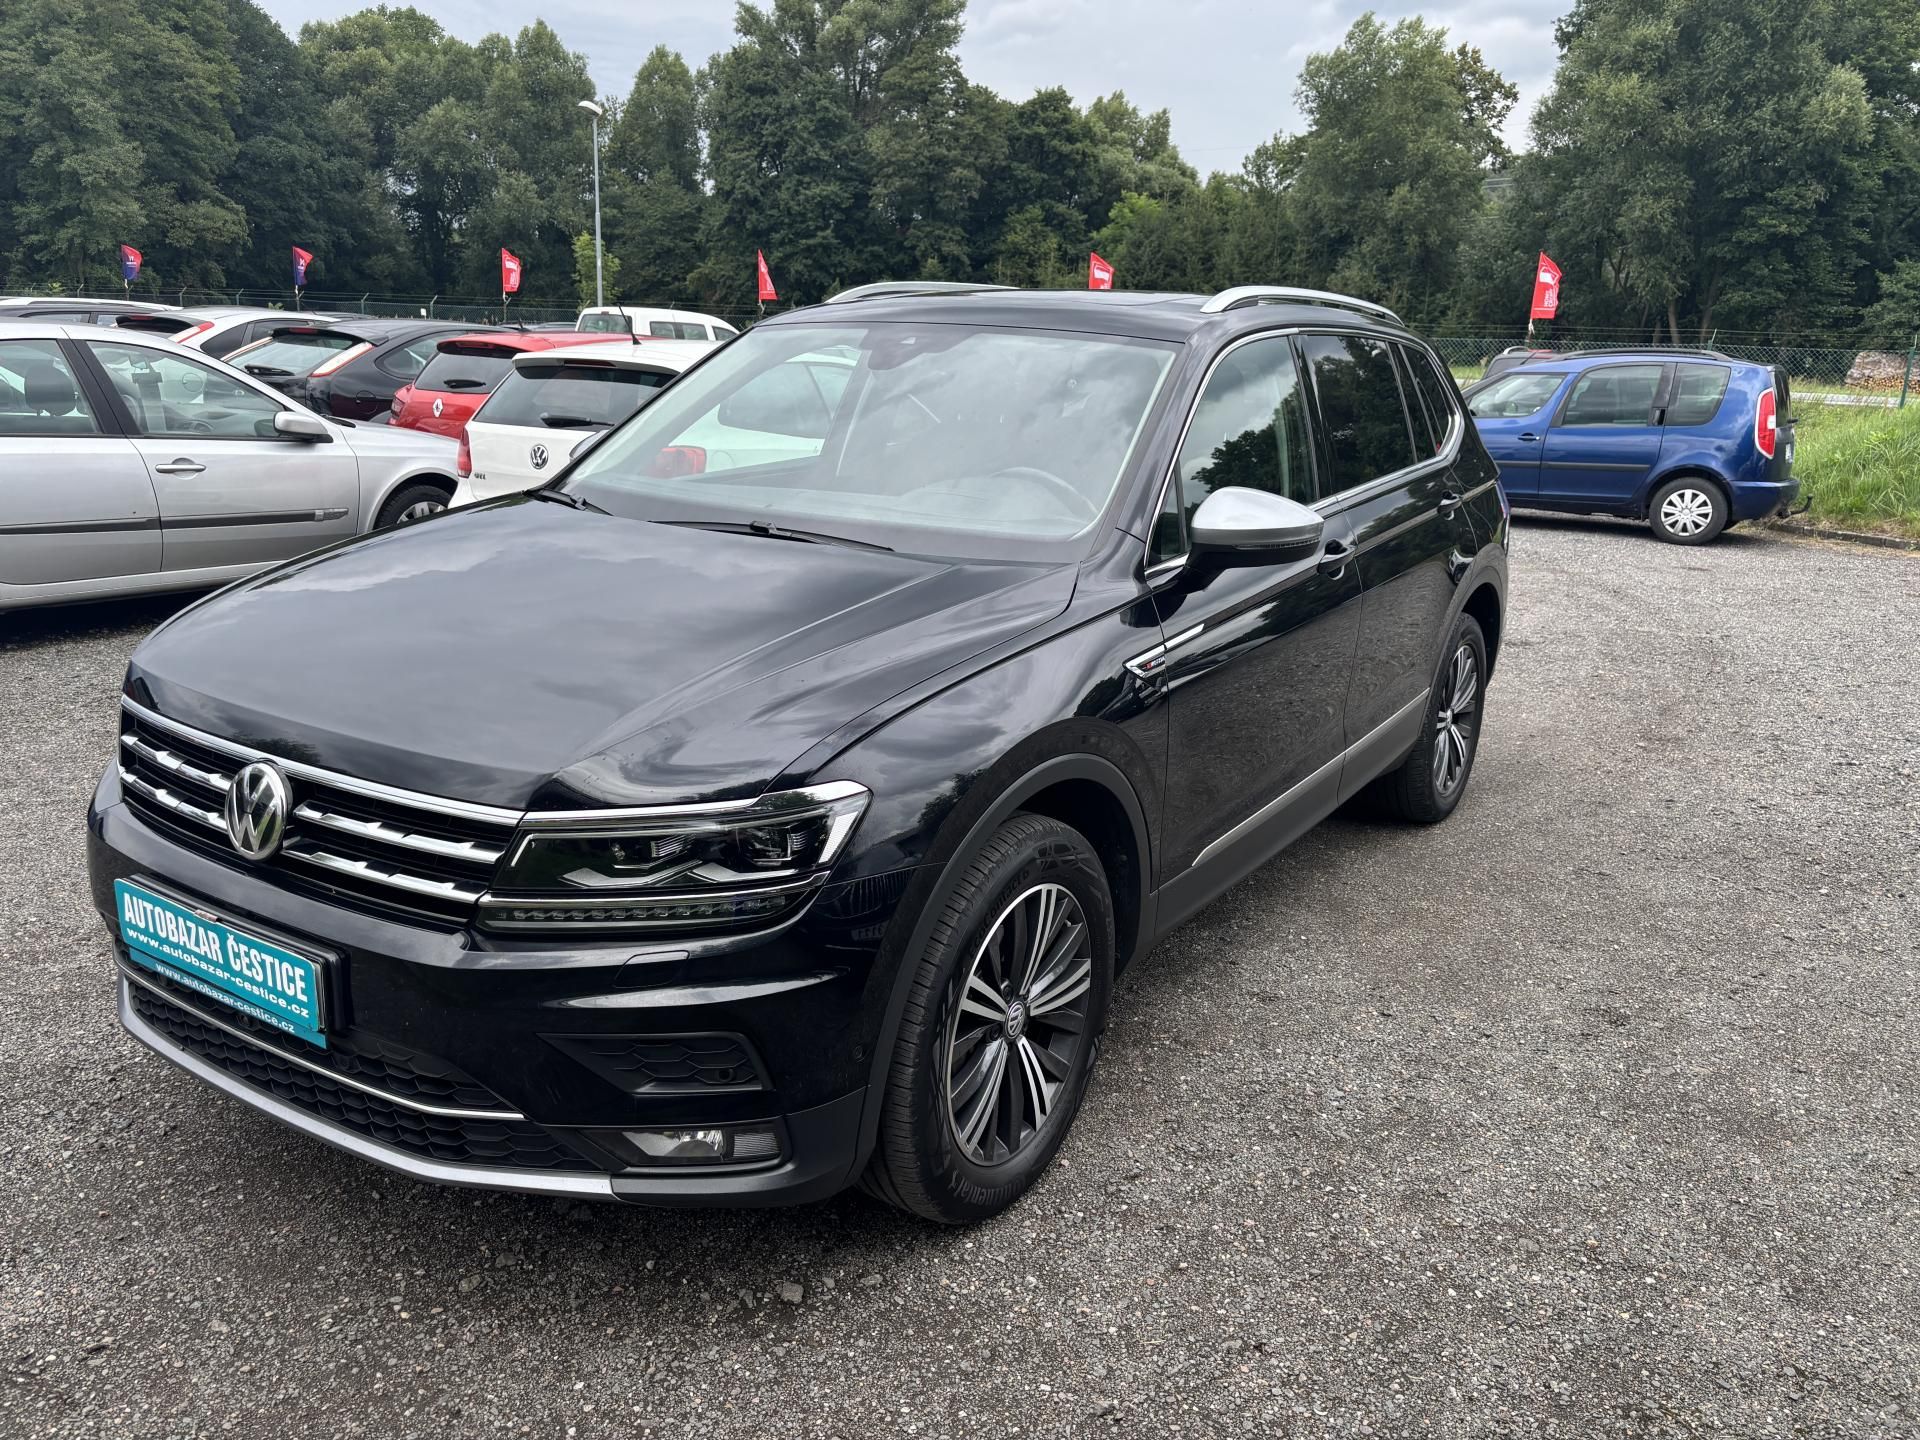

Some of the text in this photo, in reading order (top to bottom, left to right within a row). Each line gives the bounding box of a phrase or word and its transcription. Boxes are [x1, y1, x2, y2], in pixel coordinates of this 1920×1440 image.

[123, 892, 308, 1003] AUTOBAZAR ČESTICE
[126, 927, 310, 1018] www.autobazar-cestice.cz
[155, 962, 296, 1033] www.autobazar-cestice.cz
